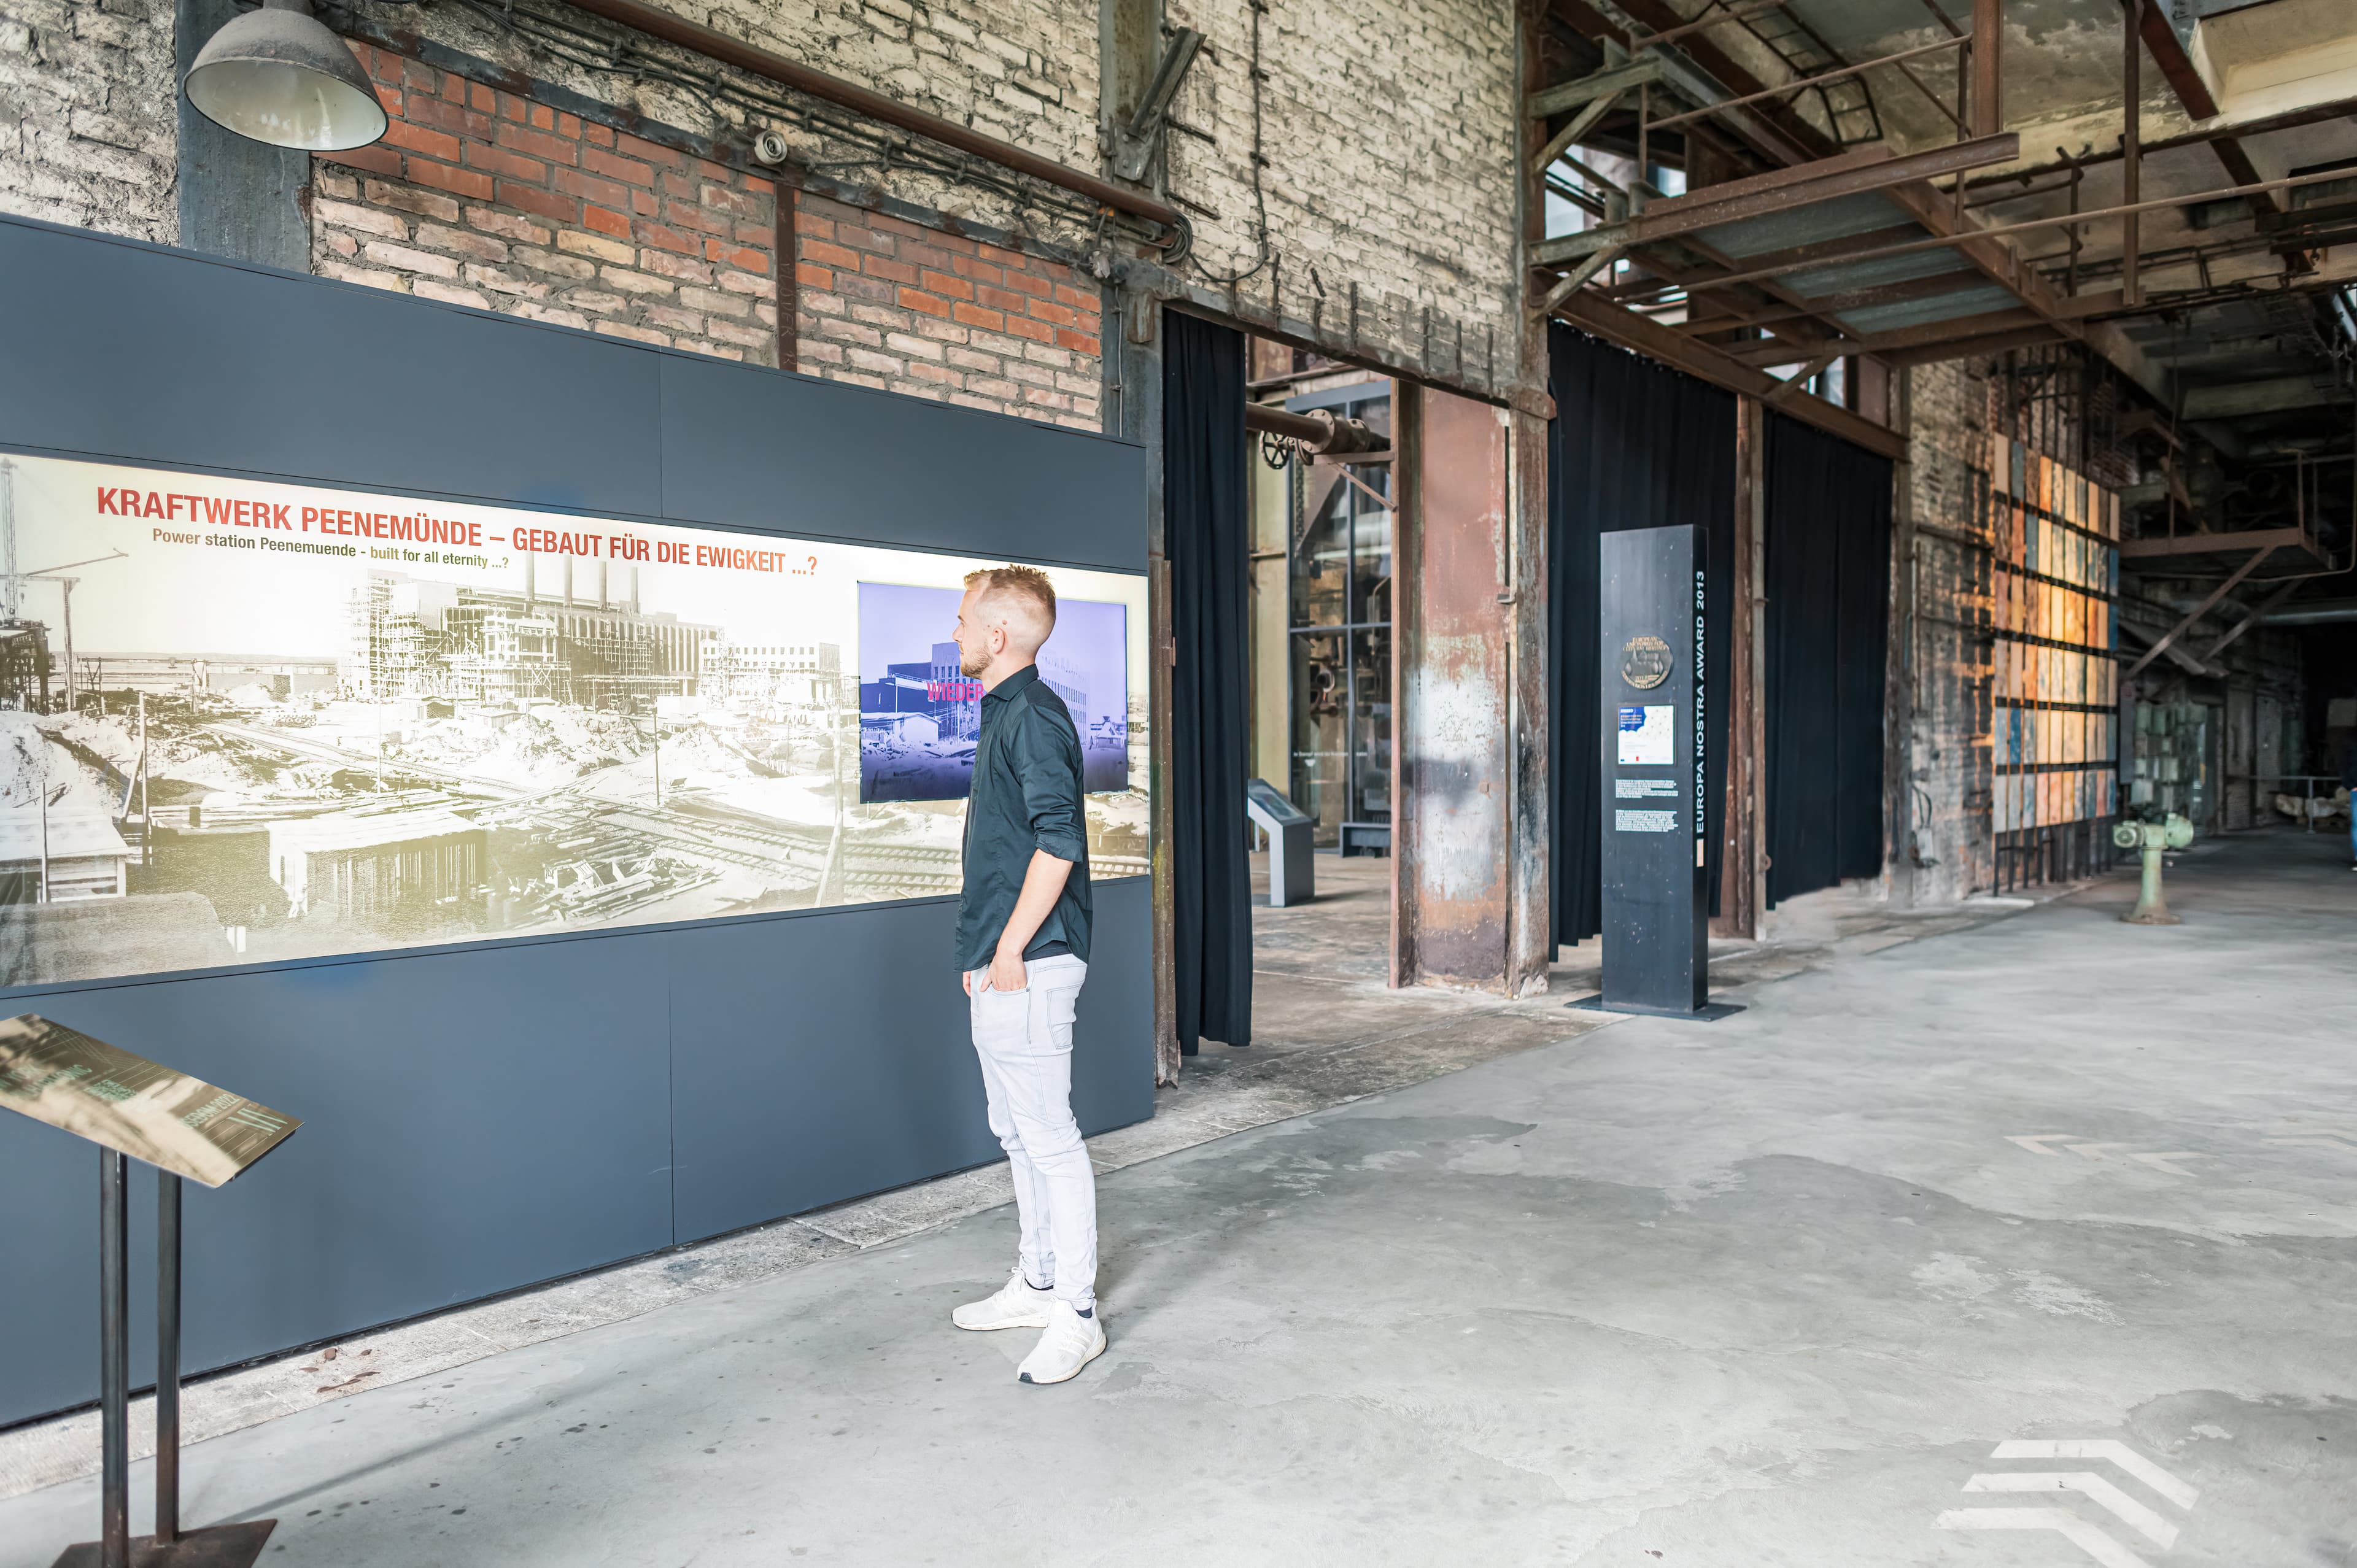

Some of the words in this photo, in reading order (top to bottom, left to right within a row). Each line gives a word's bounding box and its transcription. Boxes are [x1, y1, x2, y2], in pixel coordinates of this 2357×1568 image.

[98, 486, 292, 530] KRAFTWERK
[301, 506, 482, 547] PEENEMÜNDE
[513, 527, 603, 557] GEBAUT
[610, 533, 650, 562] FÜR
[657, 541, 690, 565] DIE
[697, 545, 786, 573] EWIGKEIT
[152, 528, 201, 544] Power
[204, 533, 255, 549] station
[260, 537, 356, 557] Peenemuende
[370, 546, 400, 560] built
[403, 549, 420, 562] for
[424, 551, 439, 563] all
[443, 553, 488, 570] eternity
[1696, 571, 1705, 610] 2013
[1696, 615, 1705, 681] AWARD
[926, 682, 985, 701] WIEDER
[1696, 684, 1705, 757] NOSTRA
[1696, 760, 1705, 833] EUROPA
[215, 1094, 240, 1110] 2022
